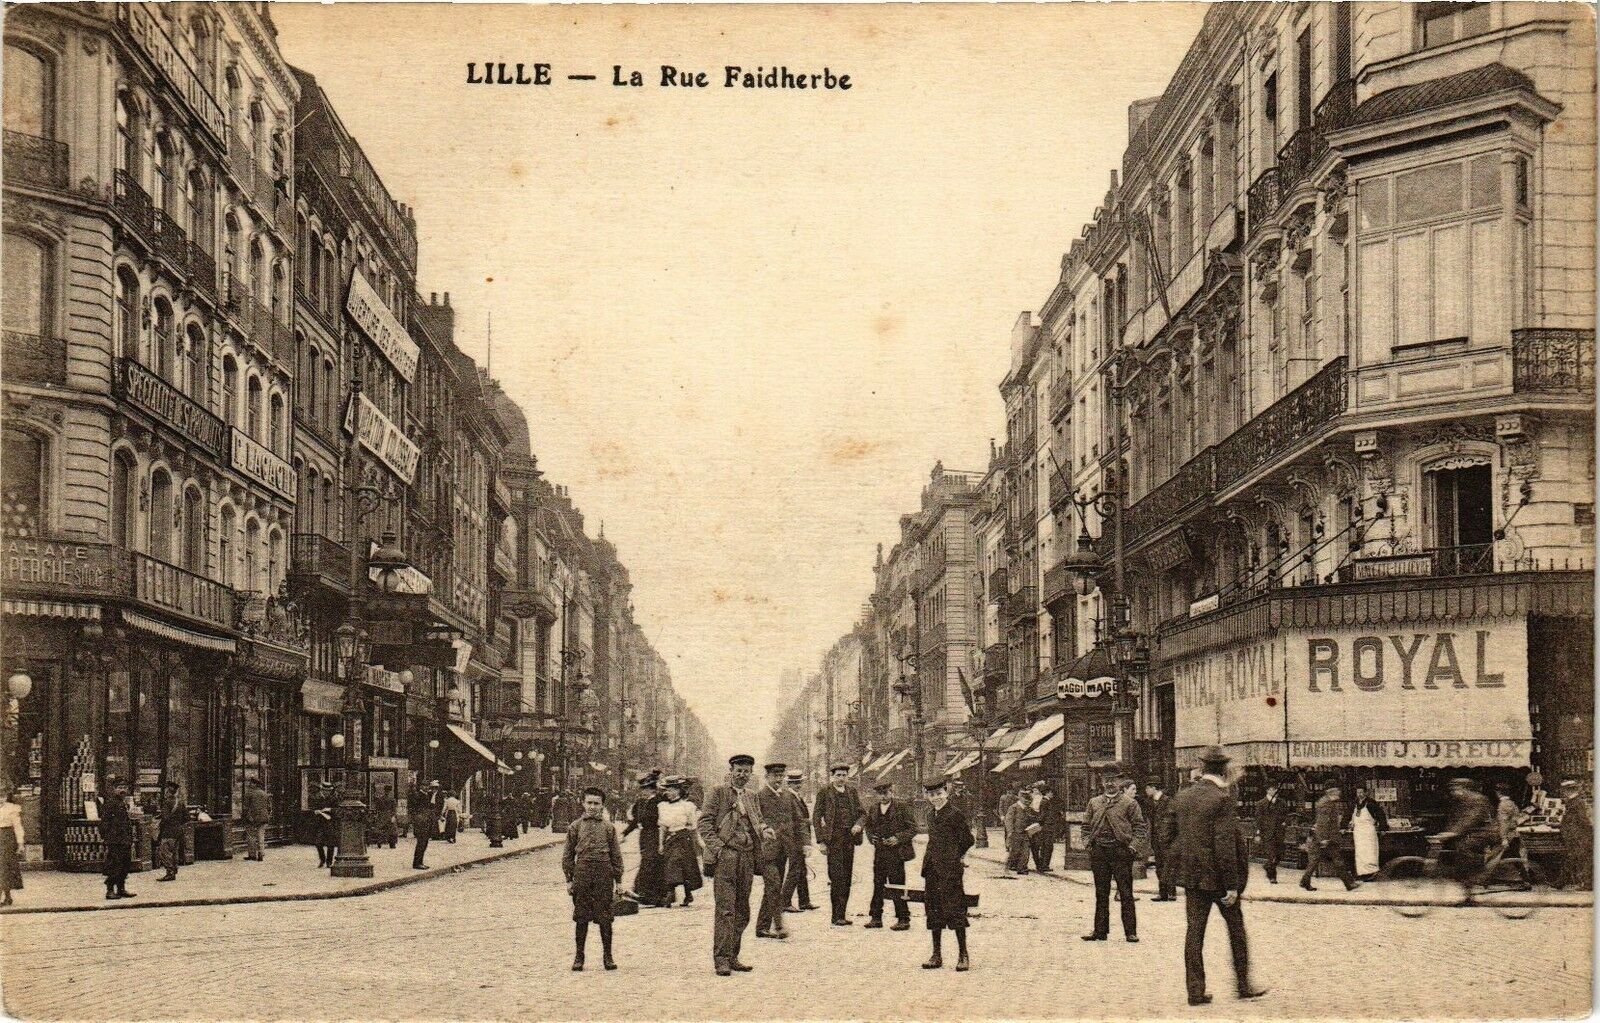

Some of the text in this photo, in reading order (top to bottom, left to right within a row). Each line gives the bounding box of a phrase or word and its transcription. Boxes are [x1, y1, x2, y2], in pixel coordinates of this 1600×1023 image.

[1307, 629, 1505, 694] ROYAL
[1224, 642, 1280, 703] ROYAL
[1058, 683, 1083, 693] MAGGI
[1089, 724, 1116, 738] BYRR
[1292, 740, 1523, 759] ETABLISSEMENTS J. DREUX
